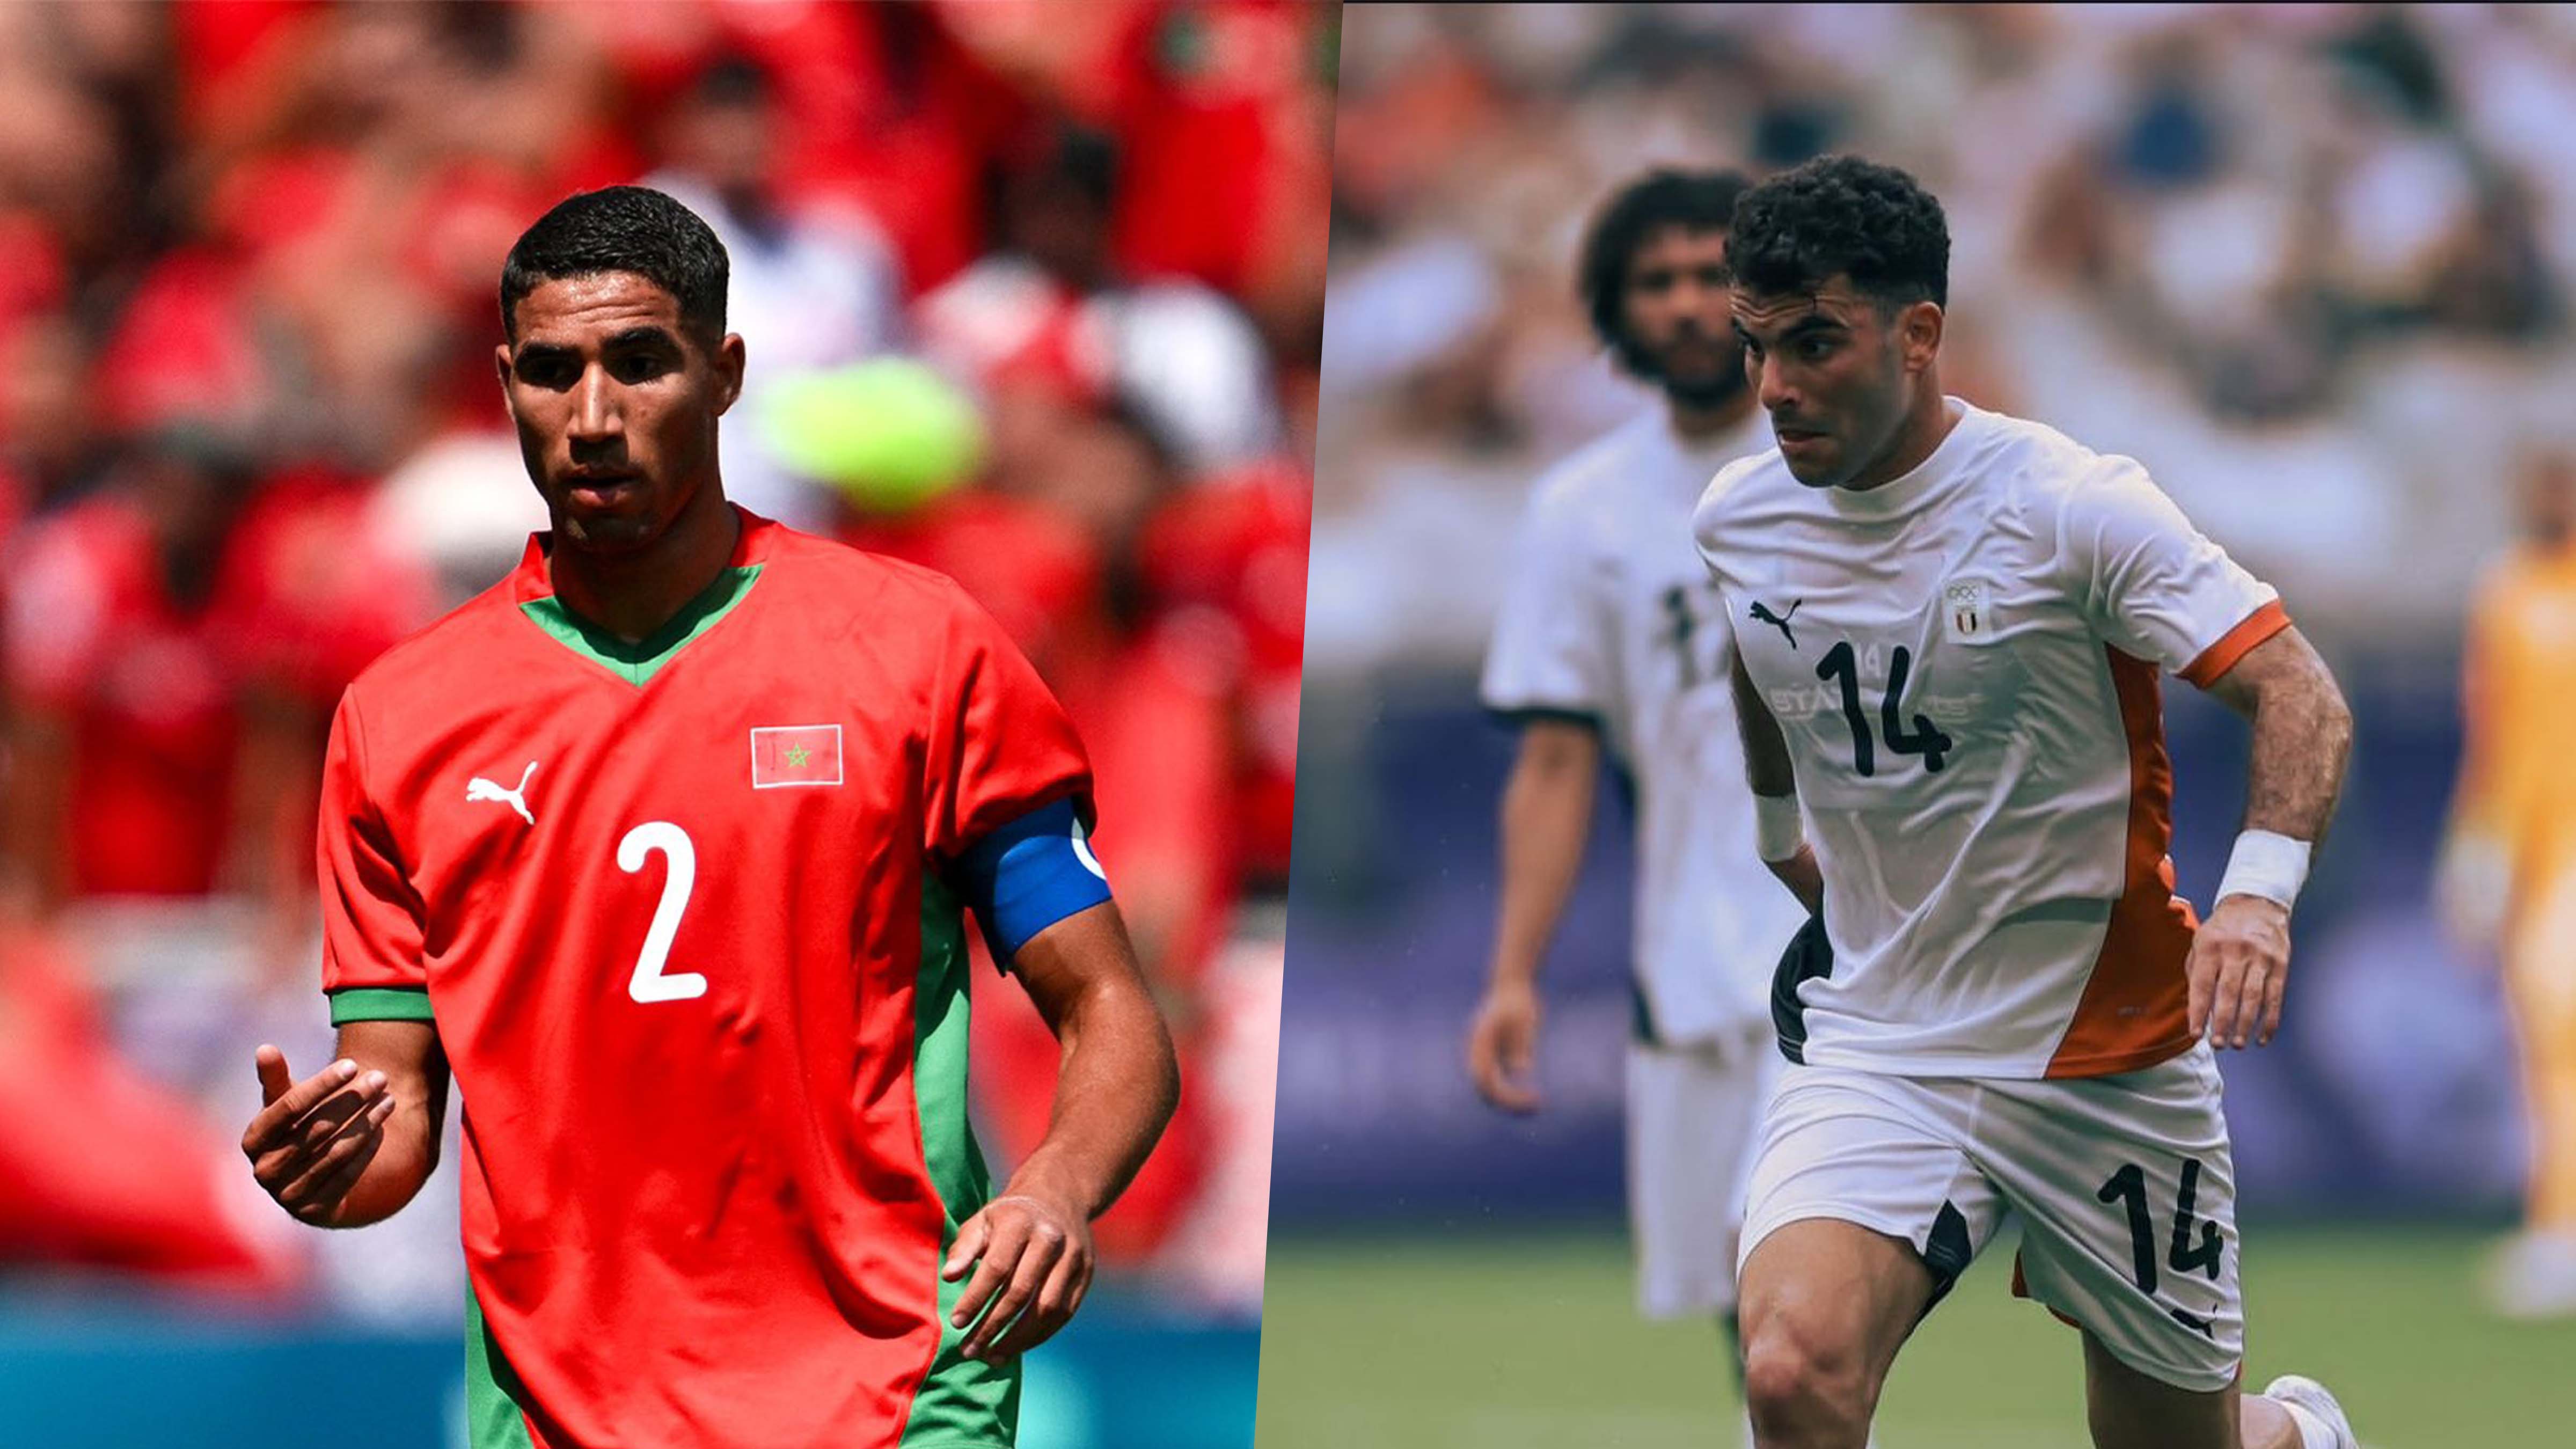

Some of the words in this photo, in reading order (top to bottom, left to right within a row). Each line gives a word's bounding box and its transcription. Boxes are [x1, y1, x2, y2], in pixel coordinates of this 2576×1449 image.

[1816, 641, 1952, 777] 14
[617, 821, 707, 1003] 2
[2097, 1158, 2223, 1295] 14
